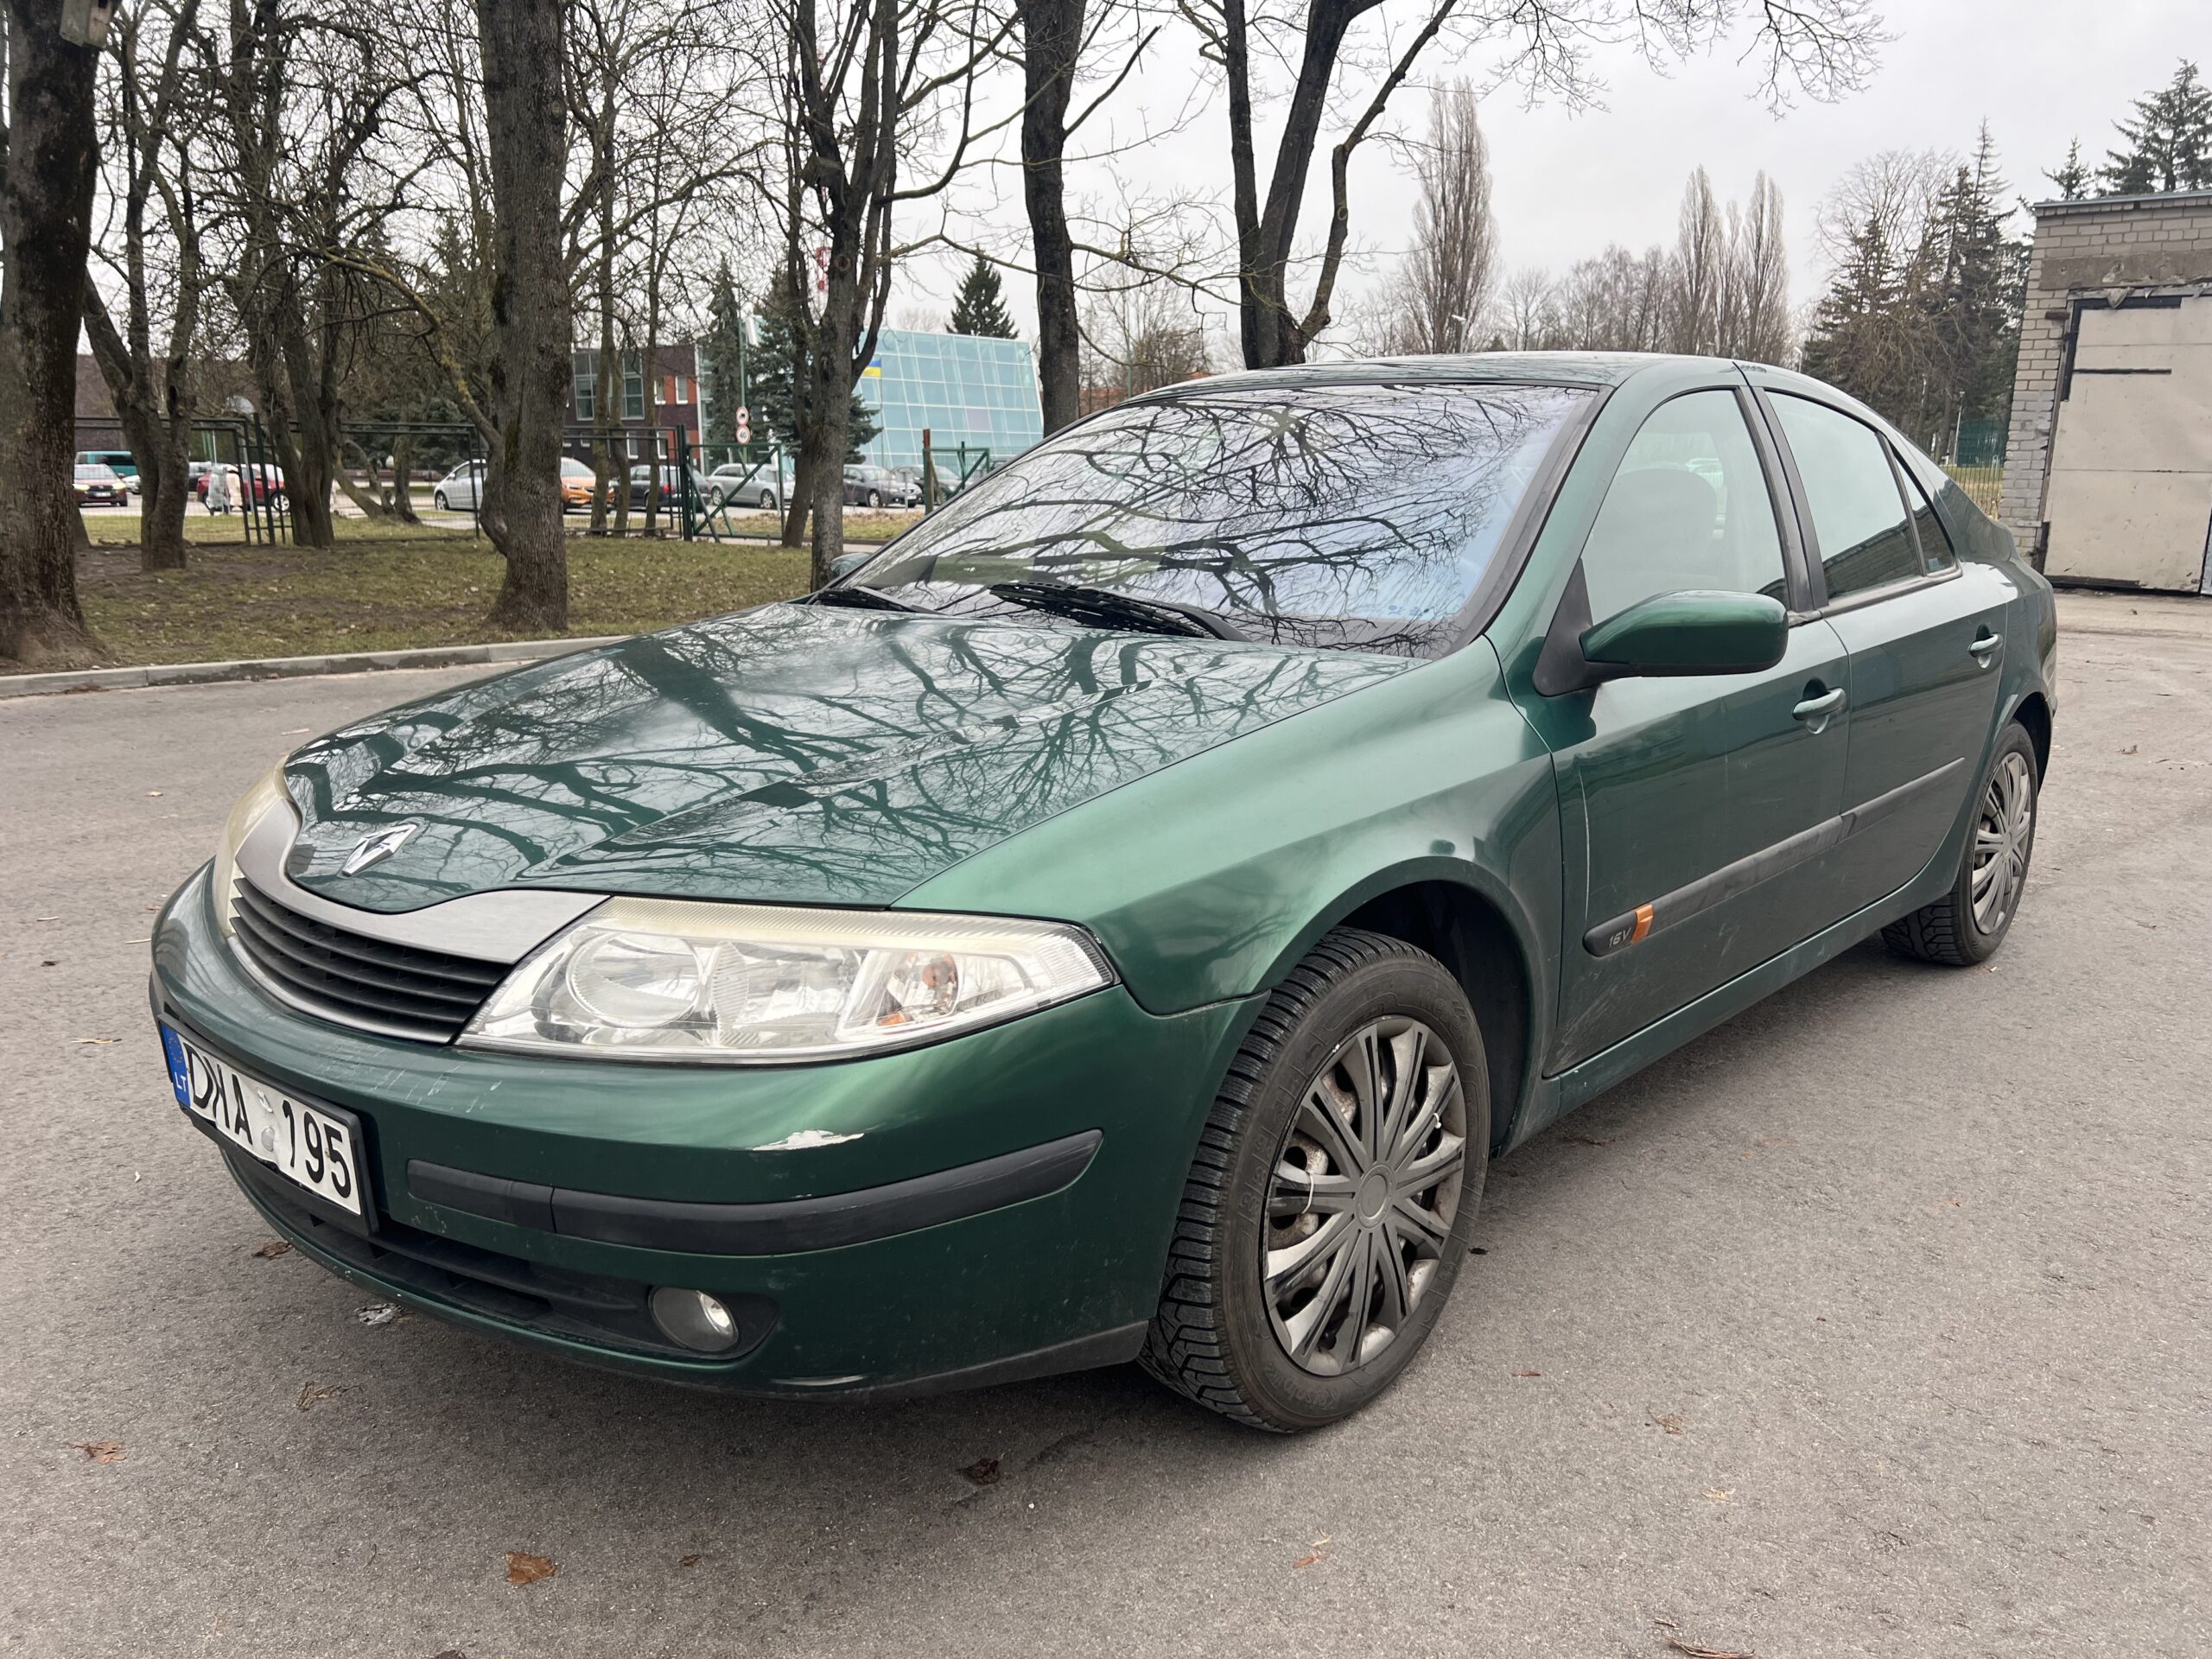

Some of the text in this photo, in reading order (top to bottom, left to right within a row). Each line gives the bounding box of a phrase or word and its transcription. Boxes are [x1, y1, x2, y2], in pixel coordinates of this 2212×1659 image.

[1608, 927, 1631, 947] 16V
[174, 1074, 187, 1093] LT
[283, 1099, 352, 1198] 195
